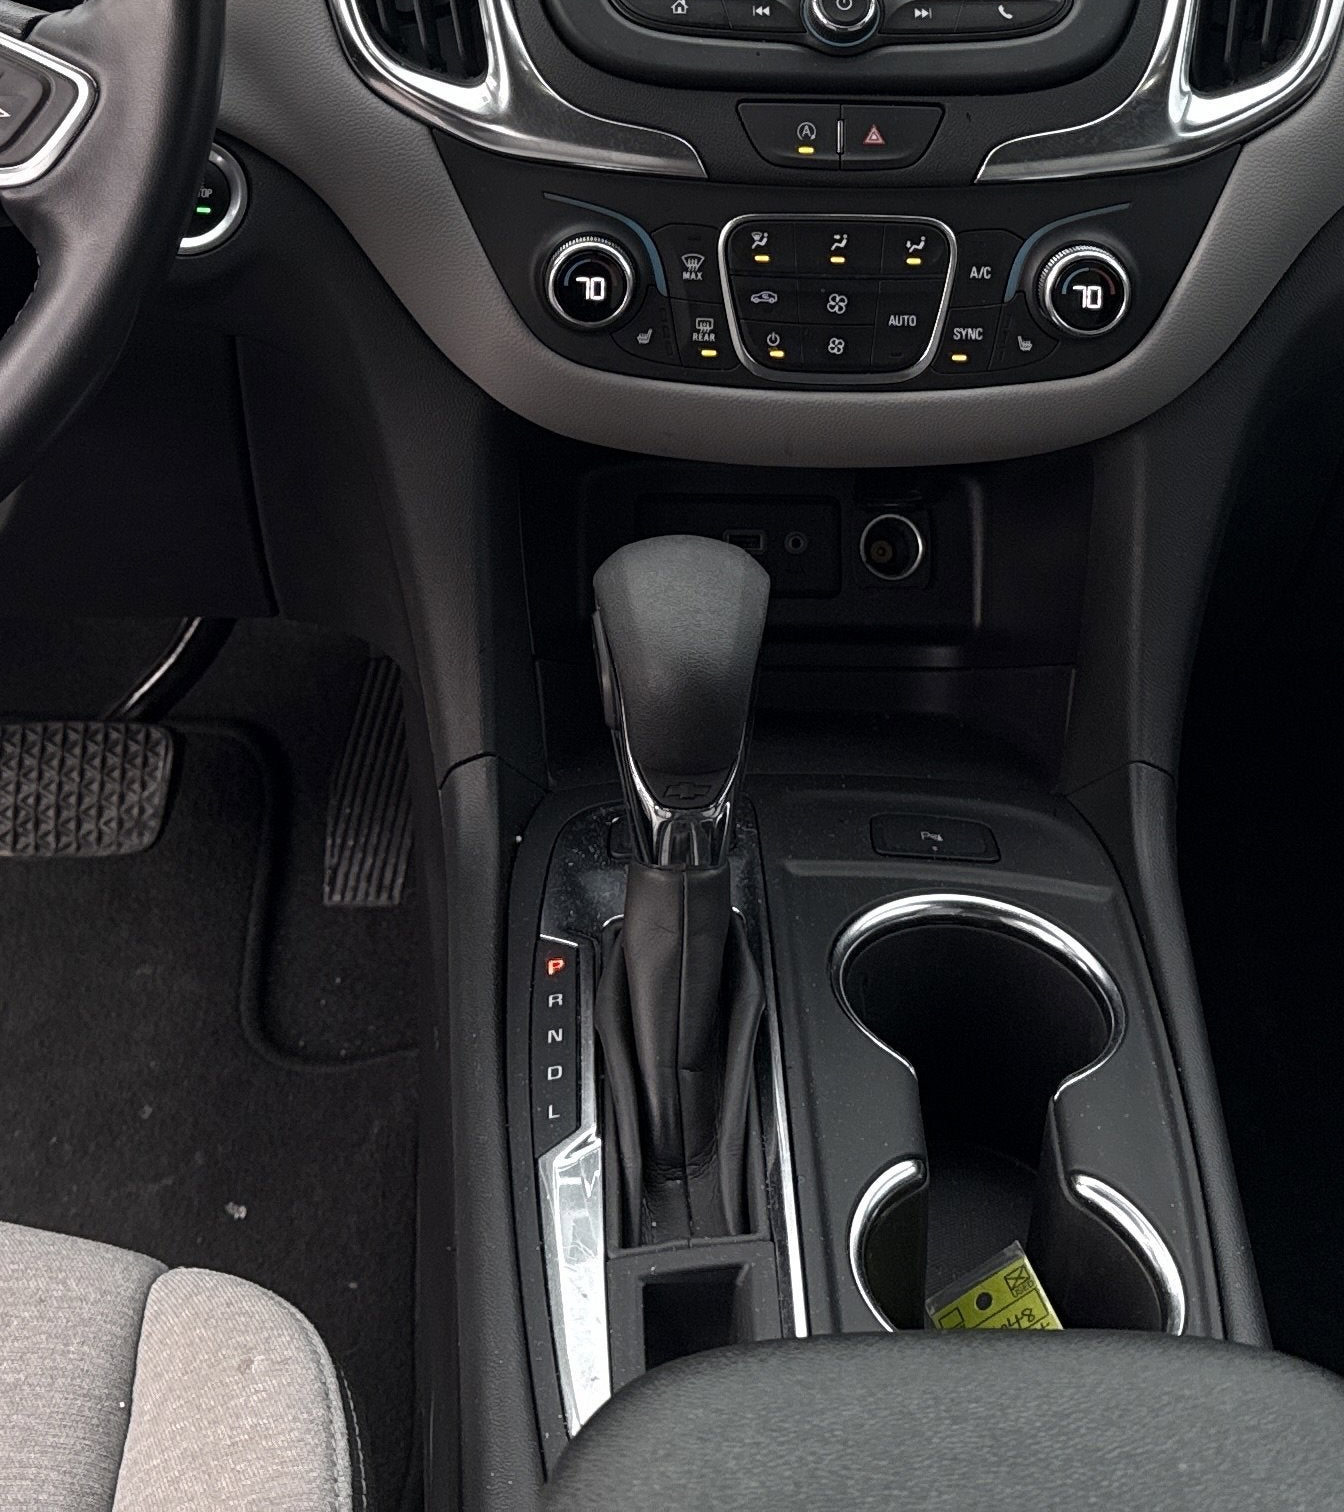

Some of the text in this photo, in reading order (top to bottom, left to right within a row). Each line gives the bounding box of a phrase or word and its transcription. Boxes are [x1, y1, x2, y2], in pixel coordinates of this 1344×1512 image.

[682, 271, 703, 281] MAX
[969, 266, 992, 280] A/C
[576, 277, 605, 300] 70
[1073, 285, 1101, 308] 70
[888, 314, 917, 327] AUTO
[692, 332, 716, 342] REAR
[953, 328, 982, 340] SYNC
[547, 958, 564, 1118] P R N D L
